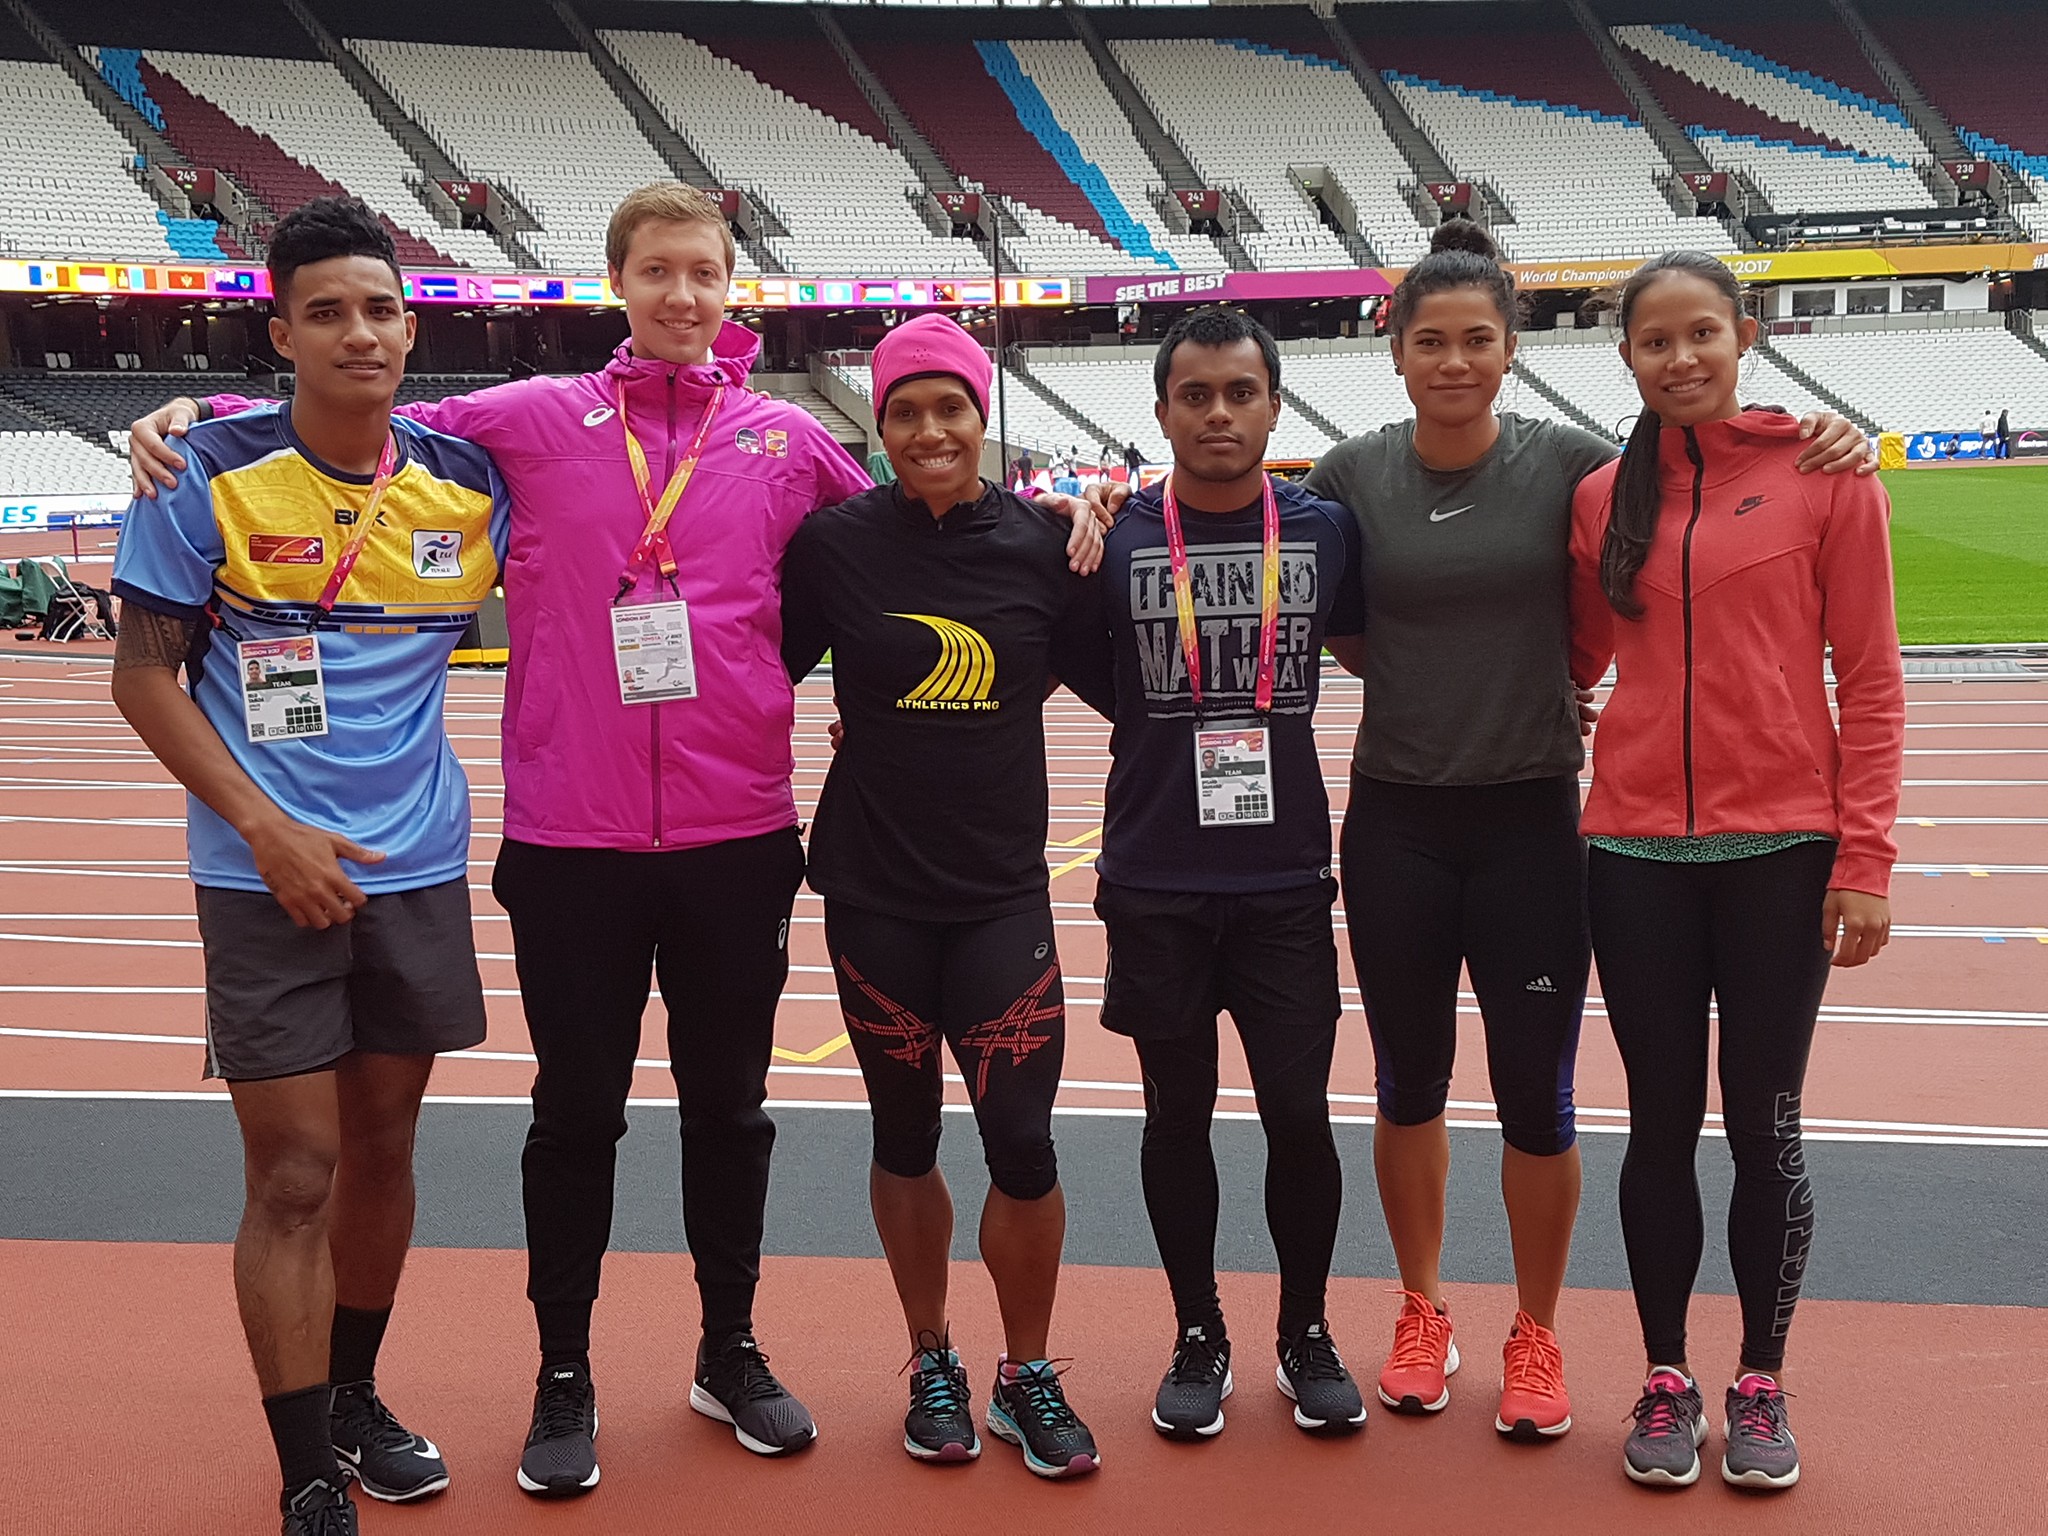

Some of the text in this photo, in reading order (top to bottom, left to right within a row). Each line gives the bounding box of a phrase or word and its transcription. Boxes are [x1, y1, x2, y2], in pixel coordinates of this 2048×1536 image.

[177, 170, 197, 181] 245
[1694, 175, 1712, 184] 239
[452, 183, 470, 194] 244
[1438, 184, 1456, 195] 240
[947, 194, 965, 204] 242
[1187, 192, 1204, 202] 241
[1735, 260, 1772, 274] 2017
[1520, 268, 1557, 283] World
[1115, 273, 1227, 302] SEE THE BEST
[2, 506, 38, 524] ES
[334, 508, 389, 527] BK
[271, 680, 292, 688] TEAM
[896, 698, 1000, 711] ATHLETICS PNG
